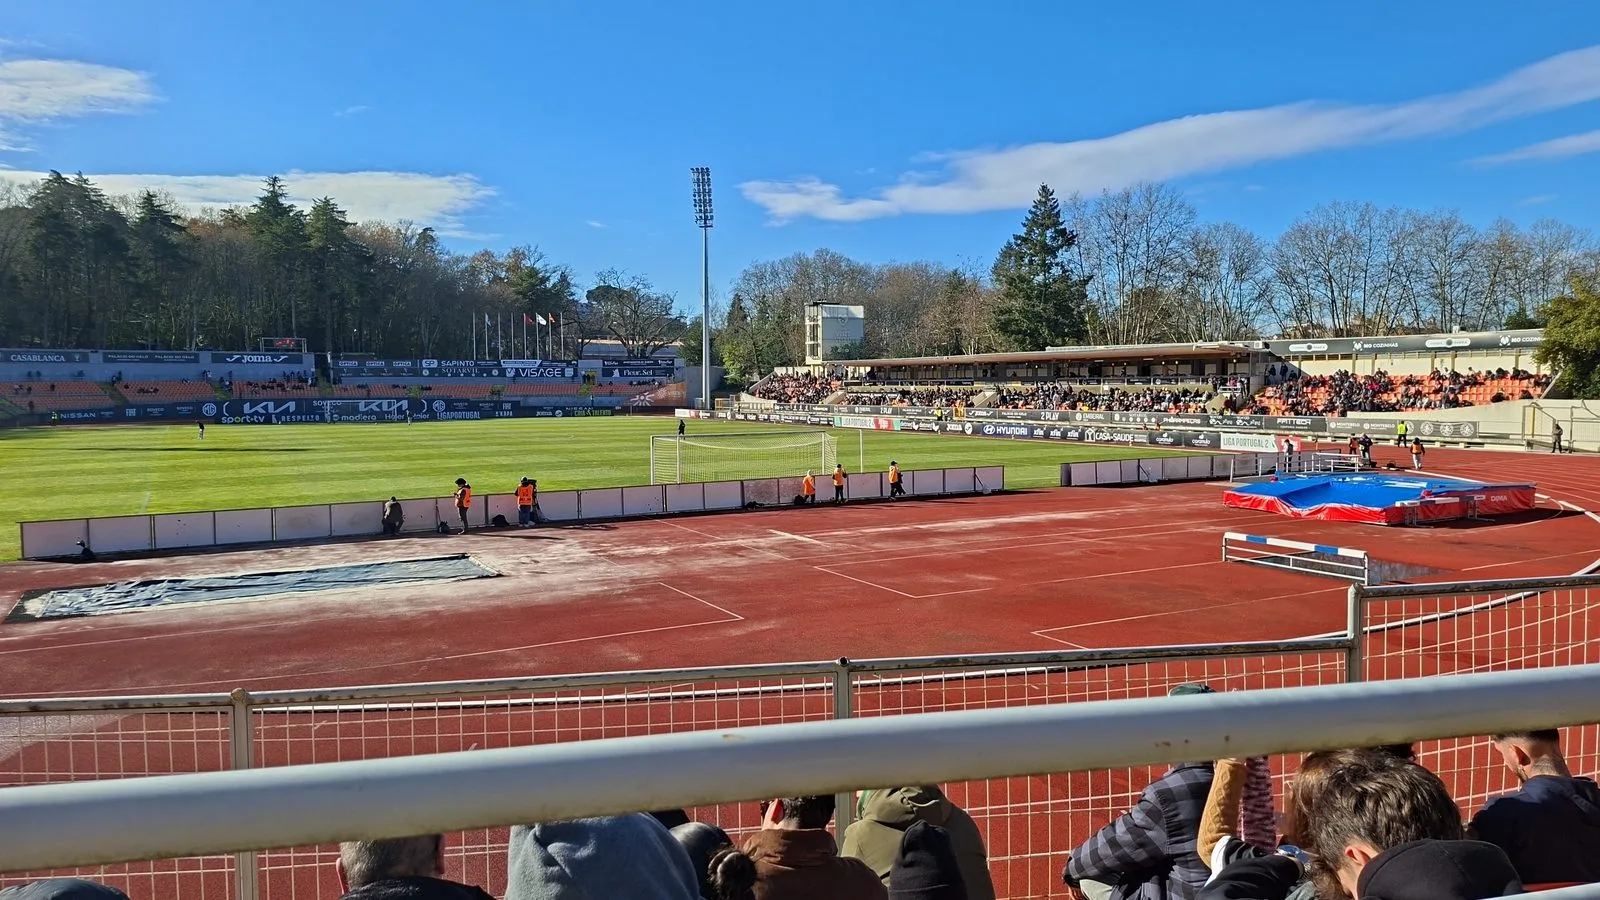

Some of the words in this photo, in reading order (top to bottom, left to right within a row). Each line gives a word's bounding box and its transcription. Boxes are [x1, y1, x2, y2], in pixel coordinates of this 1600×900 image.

[10, 354, 66, 362] CASABLANCA
[518, 368, 561, 377] VISAGE
[996, 427, 1028, 435] HYUNDAI
[1096, 432, 1111, 440] CASA
[1223, 438, 1234, 446] LIGA
[1236, 438, 1264, 448] PORTUGAL
